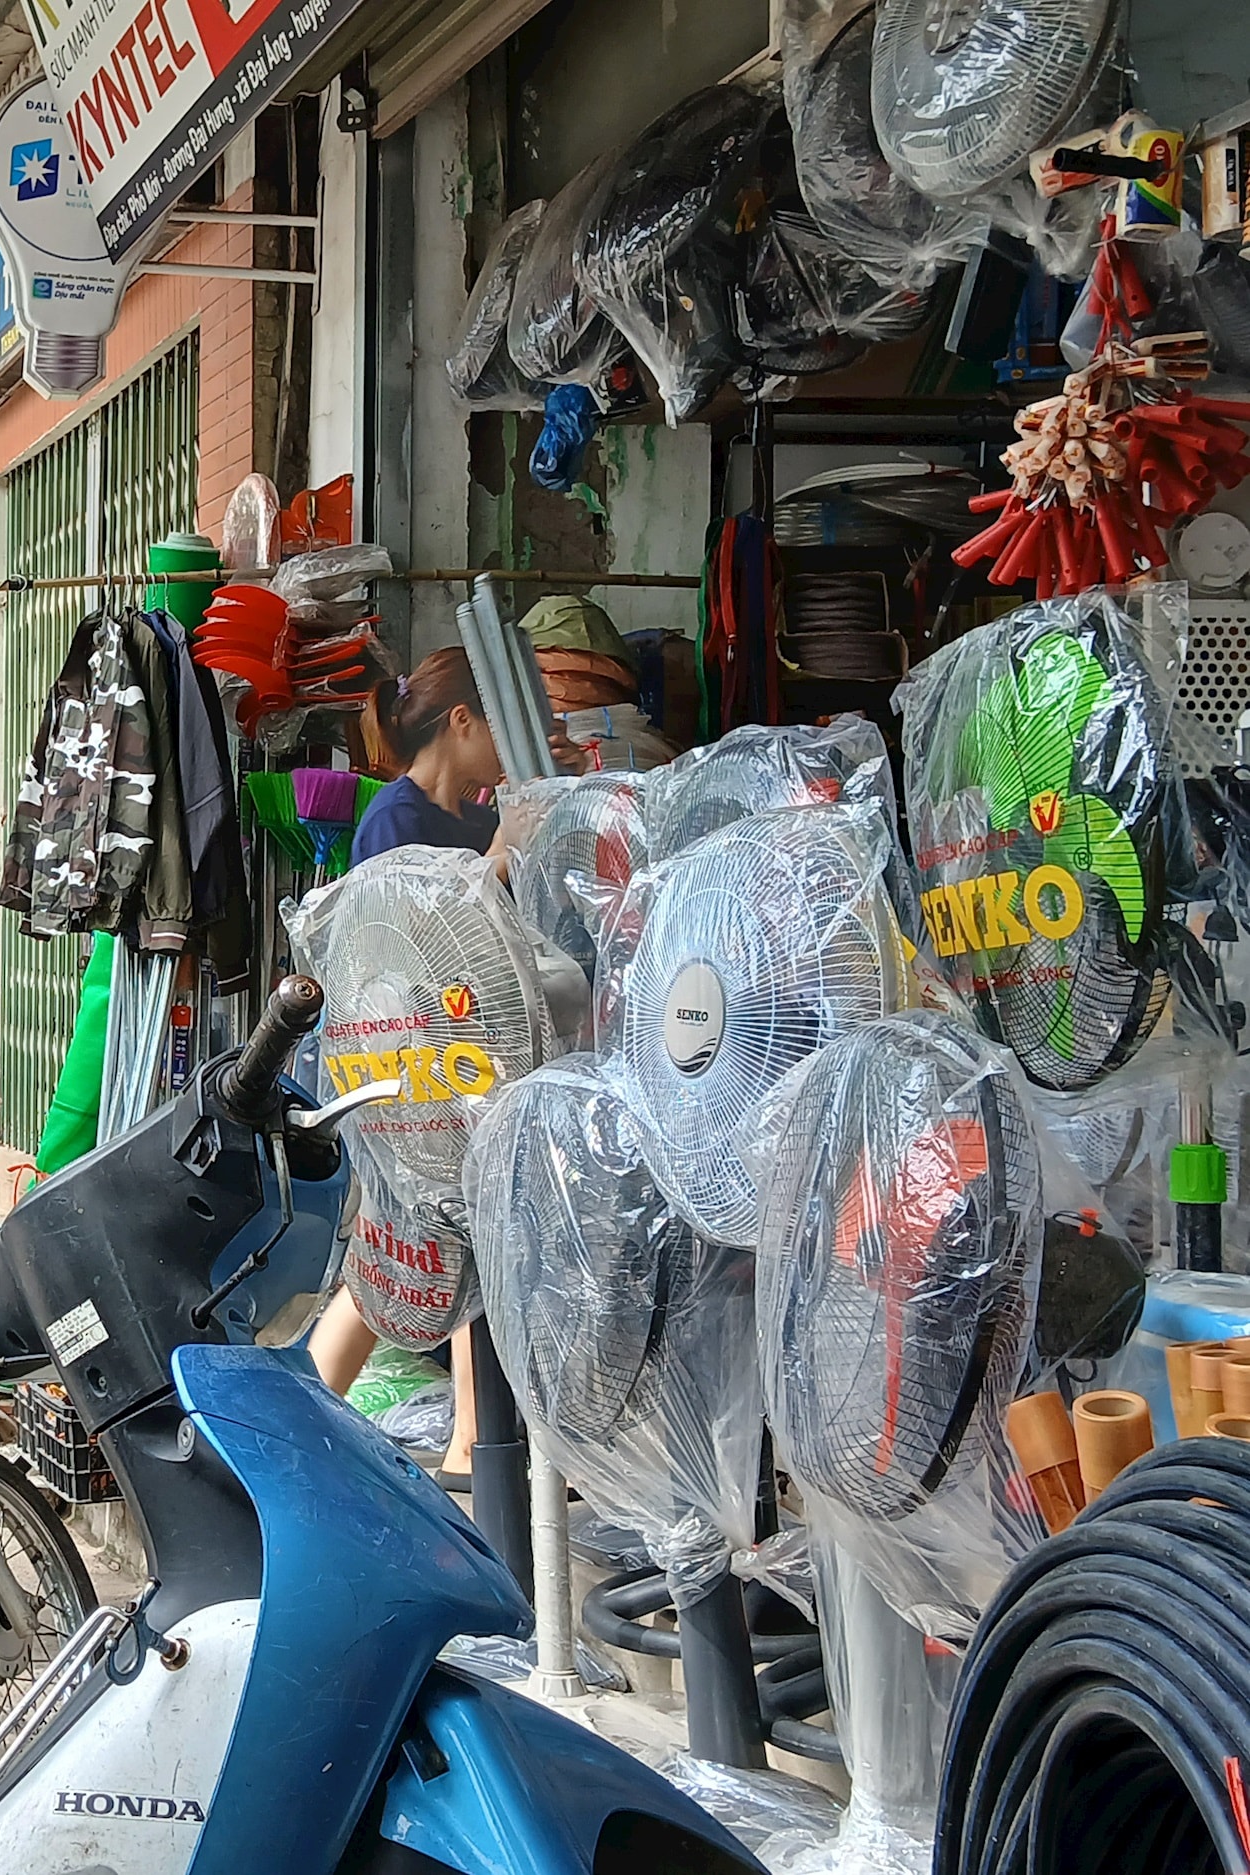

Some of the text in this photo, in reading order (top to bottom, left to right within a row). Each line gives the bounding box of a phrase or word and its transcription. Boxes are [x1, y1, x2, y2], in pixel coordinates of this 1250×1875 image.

[66, 6, 101, 58] MẠNH
[26, 100, 48, 113] ĐẠI
[102, 220, 119, 249] Địa
[127, 182, 148, 222] Phố
[141, 169, 164, 206] Mới
[162, 148, 196, 184] đường
[188, 118, 208, 152] Đại
[203, 96, 236, 137] Hưng
[235, 69, 252, 104] xã
[245, 49, 269, 87] Đại
[262, 33, 293, 71] Áng
[55, 281, 76, 291] Sáng
[920, 865, 1084, 957] SENKO
[378, 1017, 403, 1033] CAO
[676, 1009, 709, 1022] SENKO
[358, 1257, 396, 1296] THỐNG
[399, 1284, 452, 1308] NHẤT
[54, 1791, 205, 1822] HONDA
